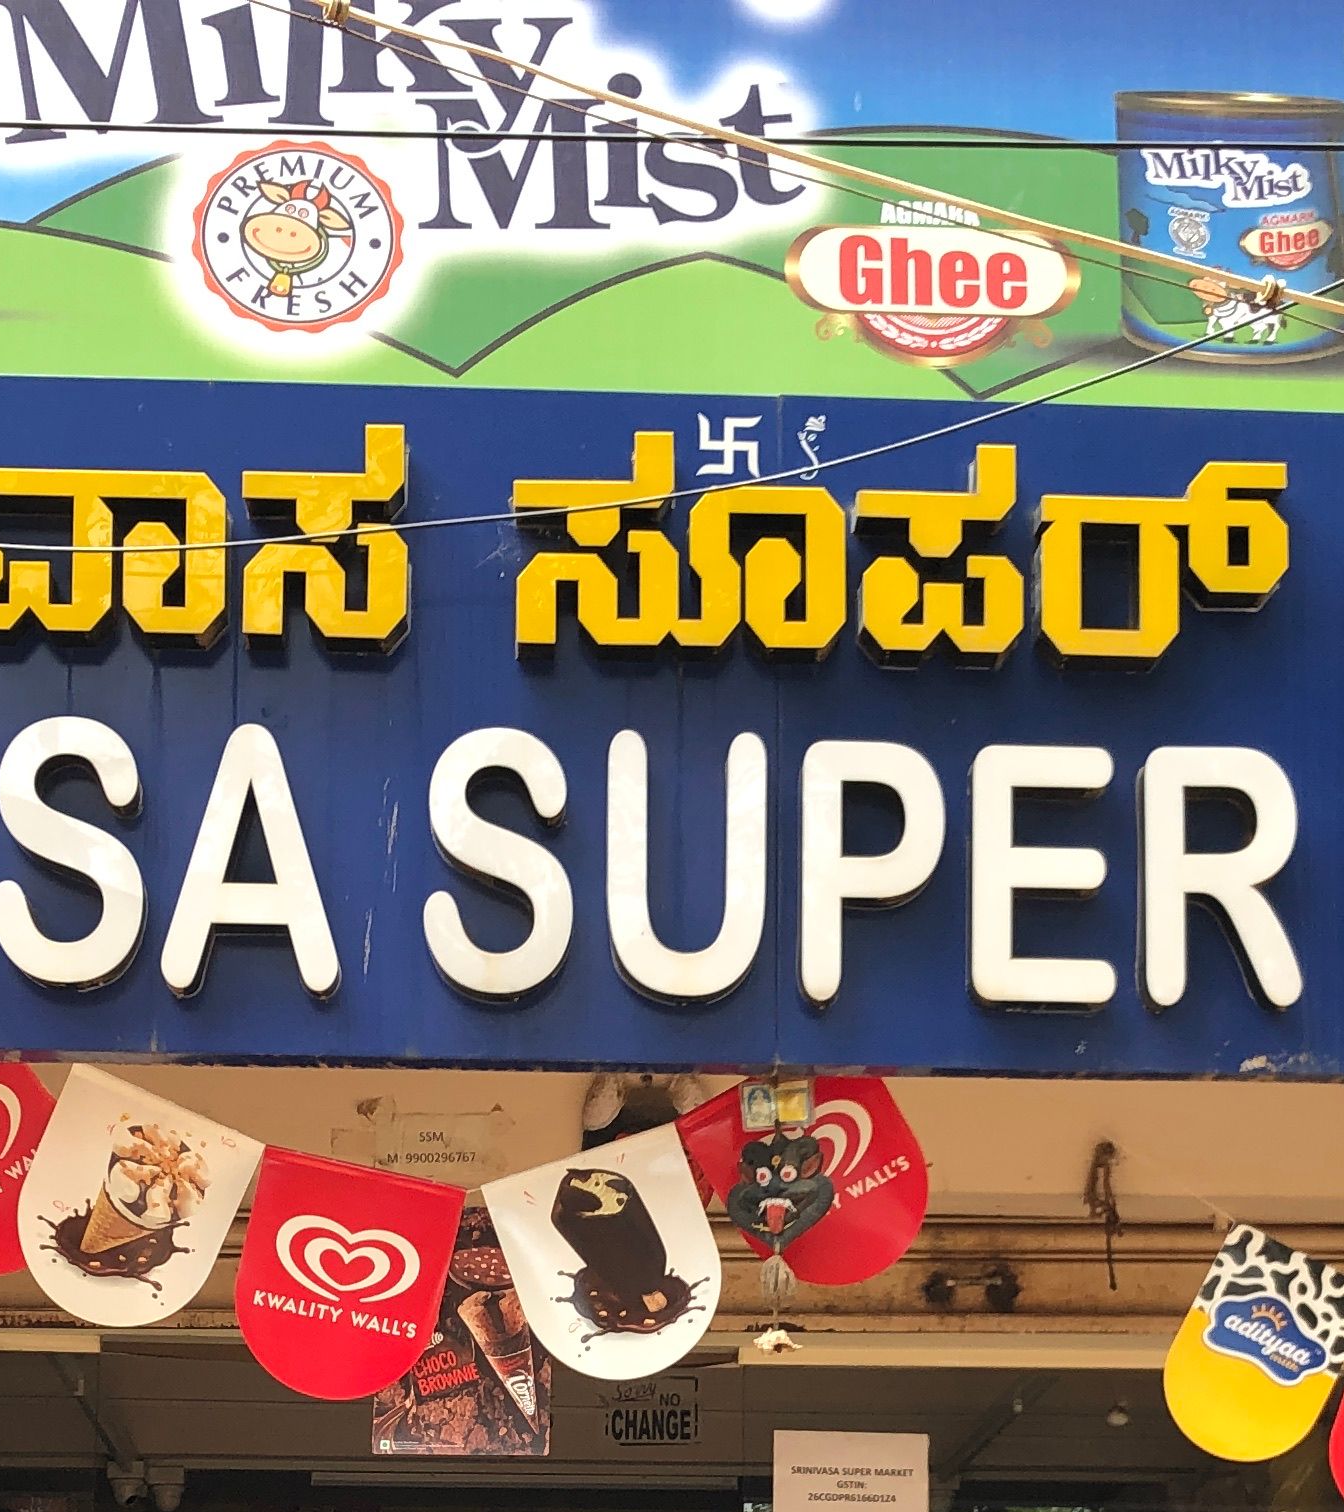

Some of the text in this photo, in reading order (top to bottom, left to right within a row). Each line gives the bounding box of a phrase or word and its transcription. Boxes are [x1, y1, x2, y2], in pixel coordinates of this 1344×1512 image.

[418, 73, 808, 231] Mist
[1149, 149, 1259, 186] Milky
[216, 155, 379, 220] PREMIUM
[1231, 169, 1304, 201] Mist
[1259, 229, 1320, 254] Ghee
[837, 233, 1029, 309] Ghee
[226, 267, 368, 316] FRESH
[511, 430, 1291, 662] ಸೂಪರ್
[423, 725, 1305, 1008] SUPER
[419, 1130, 444, 1144] SSM
[404, 1150, 477, 1165] 9900296767
[844, 1154, 912, 1201] WALL'S
[253, 1288, 418, 1340] KWALITY WALL'S
[1223, 1311, 1312, 1367] adityaa
[413, 1349, 457, 1379] CHOCO
[417, 1362, 481, 1397] BROWNIE
[659, 1393, 681, 1407] NO
[610, 1408, 691, 1441] CHANGE
[791, 1466, 914, 1477] SRINIVASA SUPER MARKET
[836, 1480, 868, 1489] GSTIN:
